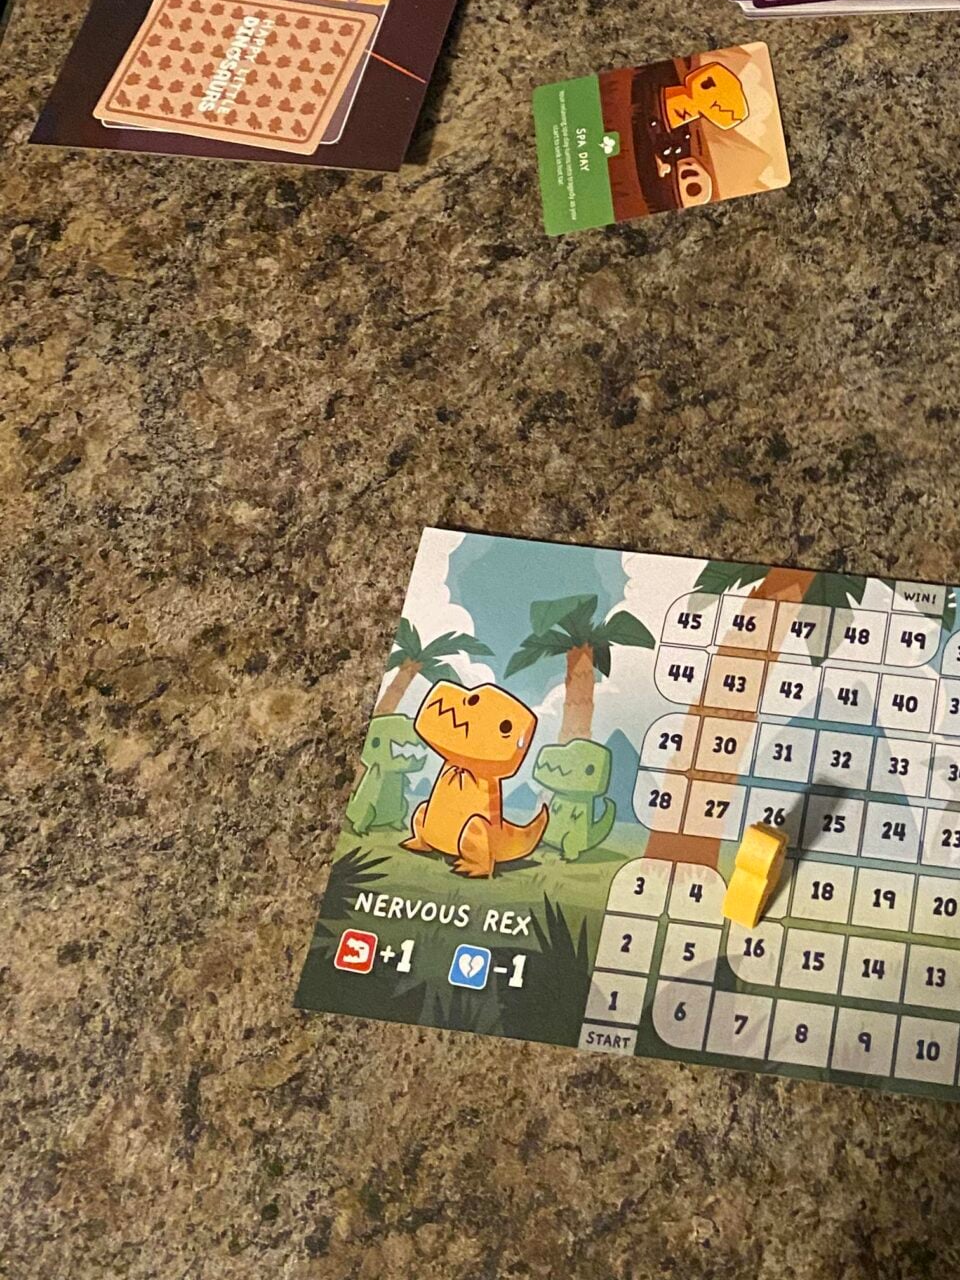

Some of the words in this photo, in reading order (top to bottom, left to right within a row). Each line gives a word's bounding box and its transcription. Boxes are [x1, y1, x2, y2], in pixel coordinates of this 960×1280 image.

[250, 18, 276, 63] HAPPY
[198, 16, 260, 113] DINOSAURS
[217, 68, 250, 115] LITTLE
[576, 127, 588, 149] SPA
[578, 151, 590, 173] DAY
[904, 590, 937, 606] WIN!
[678, 612, 702, 629] 45
[733, 615, 756, 632] 46
[791, 622, 816, 639] 47
[844, 627, 870, 644] 48
[901, 631, 926, 649] 49
[659, 733, 682, 751] 29
[713, 736, 736, 754] 30
[773, 744, 792, 762] 31
[830, 750, 851, 768] 32
[888, 757, 909, 775] 33
[634, 877, 645, 895] 3
[690, 884, 702, 902] 4
[354, 891, 471, 929] NERVOUS
[482, 909, 533, 937] REX
[379, 939, 416, 974] +1
[493, 953, 528, 989] -1
[621, 934, 632, 952] 2
[683, 942, 695, 961] 5
[744, 938, 764, 958] 16
[802, 951, 824, 971] 15
[862, 959, 884, 979] 14
[926, 967, 946, 987] 13
[585, 1028, 632, 1051] START
[608, 991, 618, 1010] 1
[674, 1002, 686, 1021] 6
[735, 1015, 748, 1034] 7
[795, 1024, 808, 1043] 8
[858, 1032, 871, 1052] 9
[916, 1040, 940, 1061] 10
